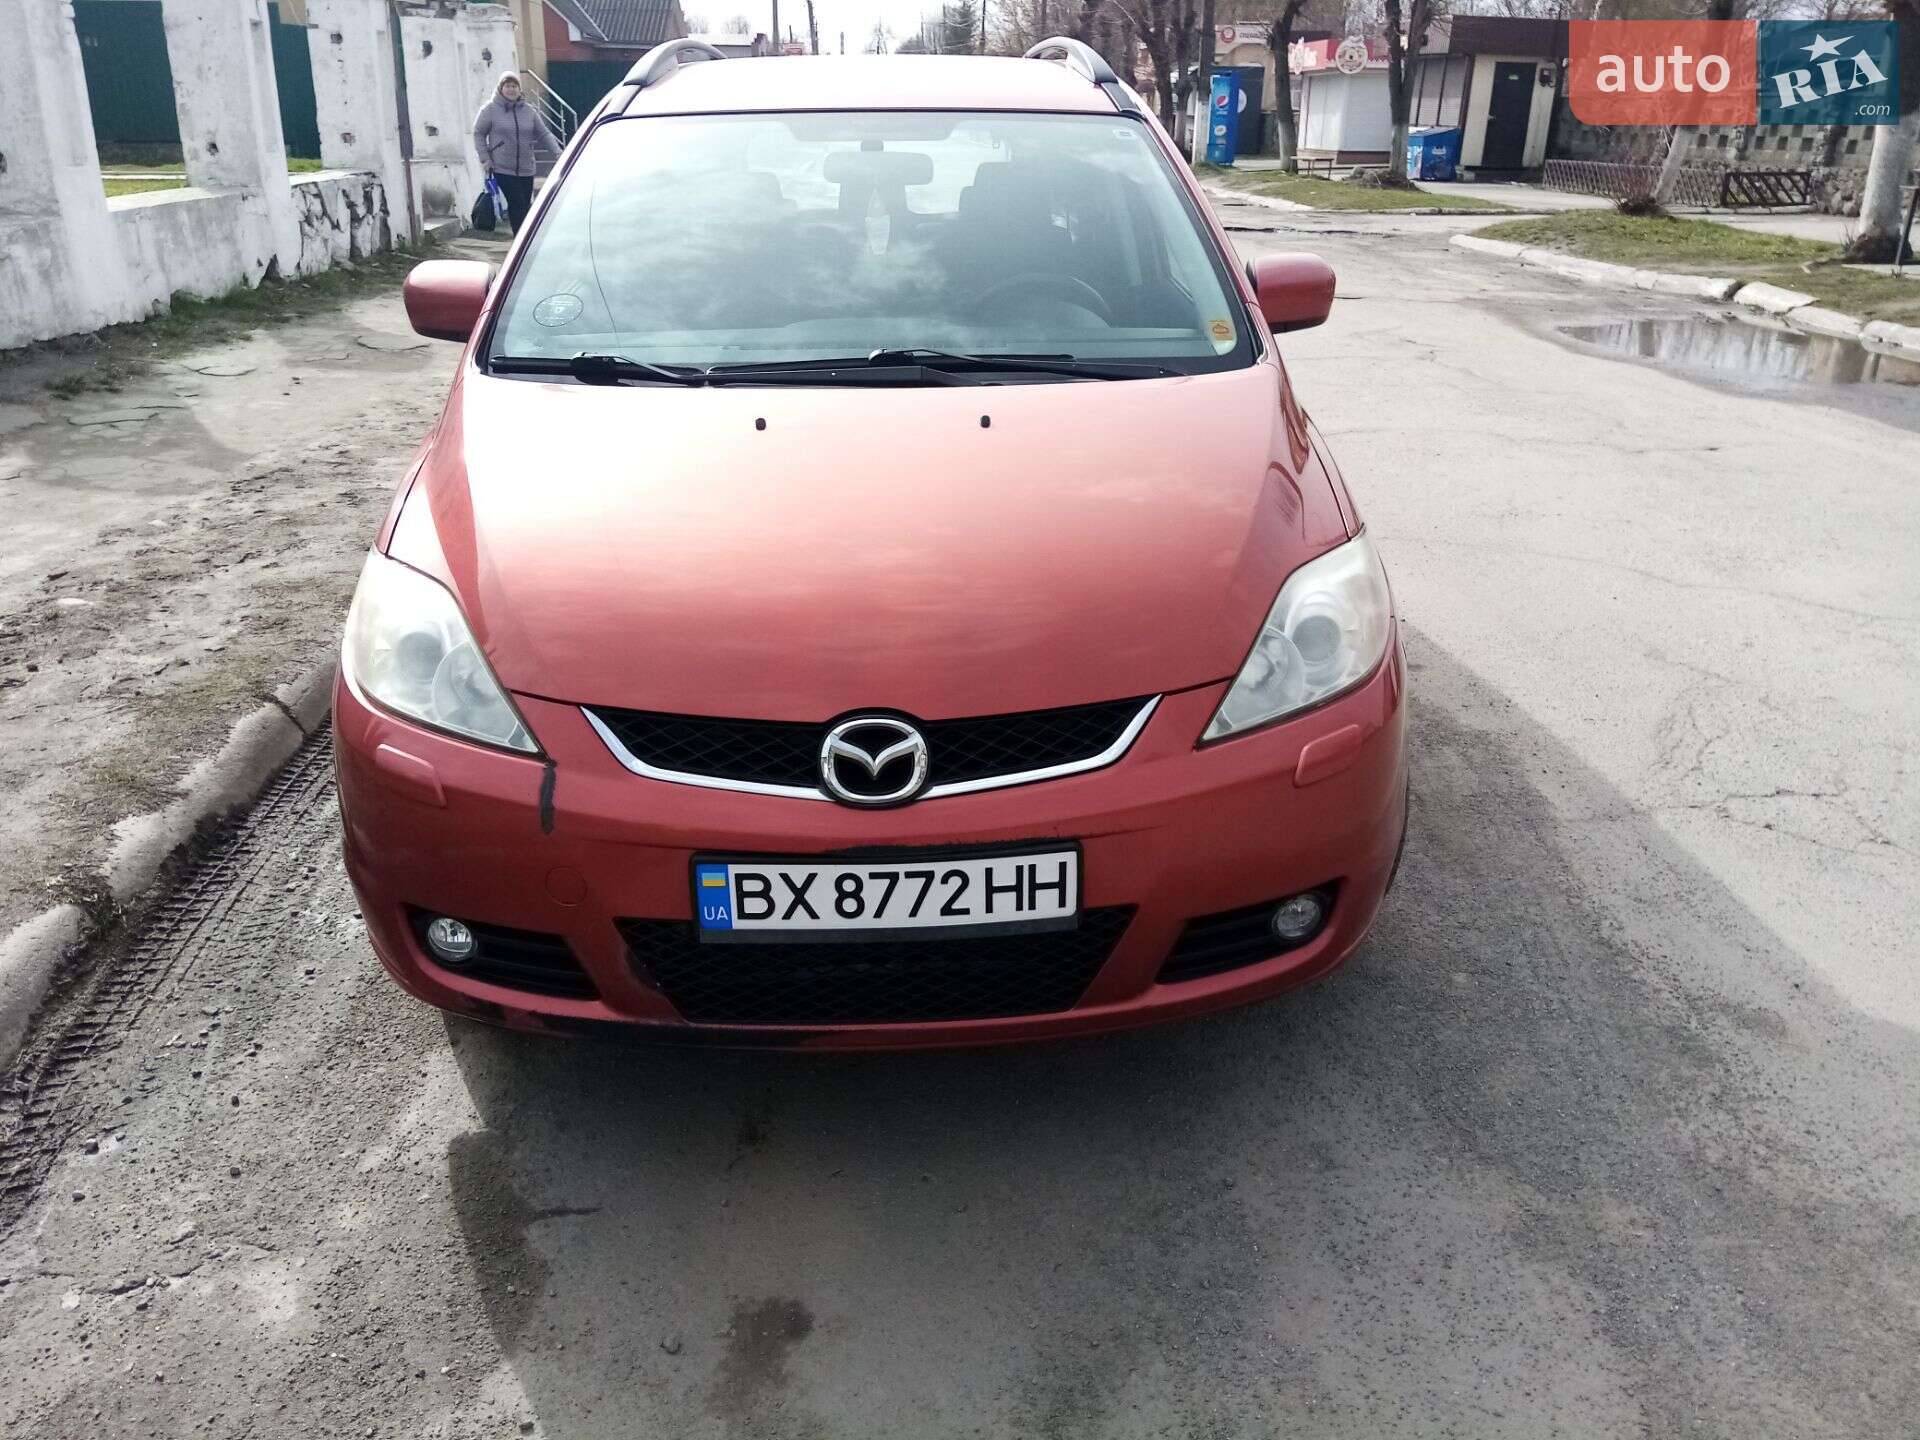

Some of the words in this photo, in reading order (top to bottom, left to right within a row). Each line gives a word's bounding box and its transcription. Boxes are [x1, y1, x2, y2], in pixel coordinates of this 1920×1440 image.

[734, 872, 821, 921] BX
[833, 869, 972, 920] 8772
[984, 861, 1068, 915] HH
[704, 906, 729, 922] UA
